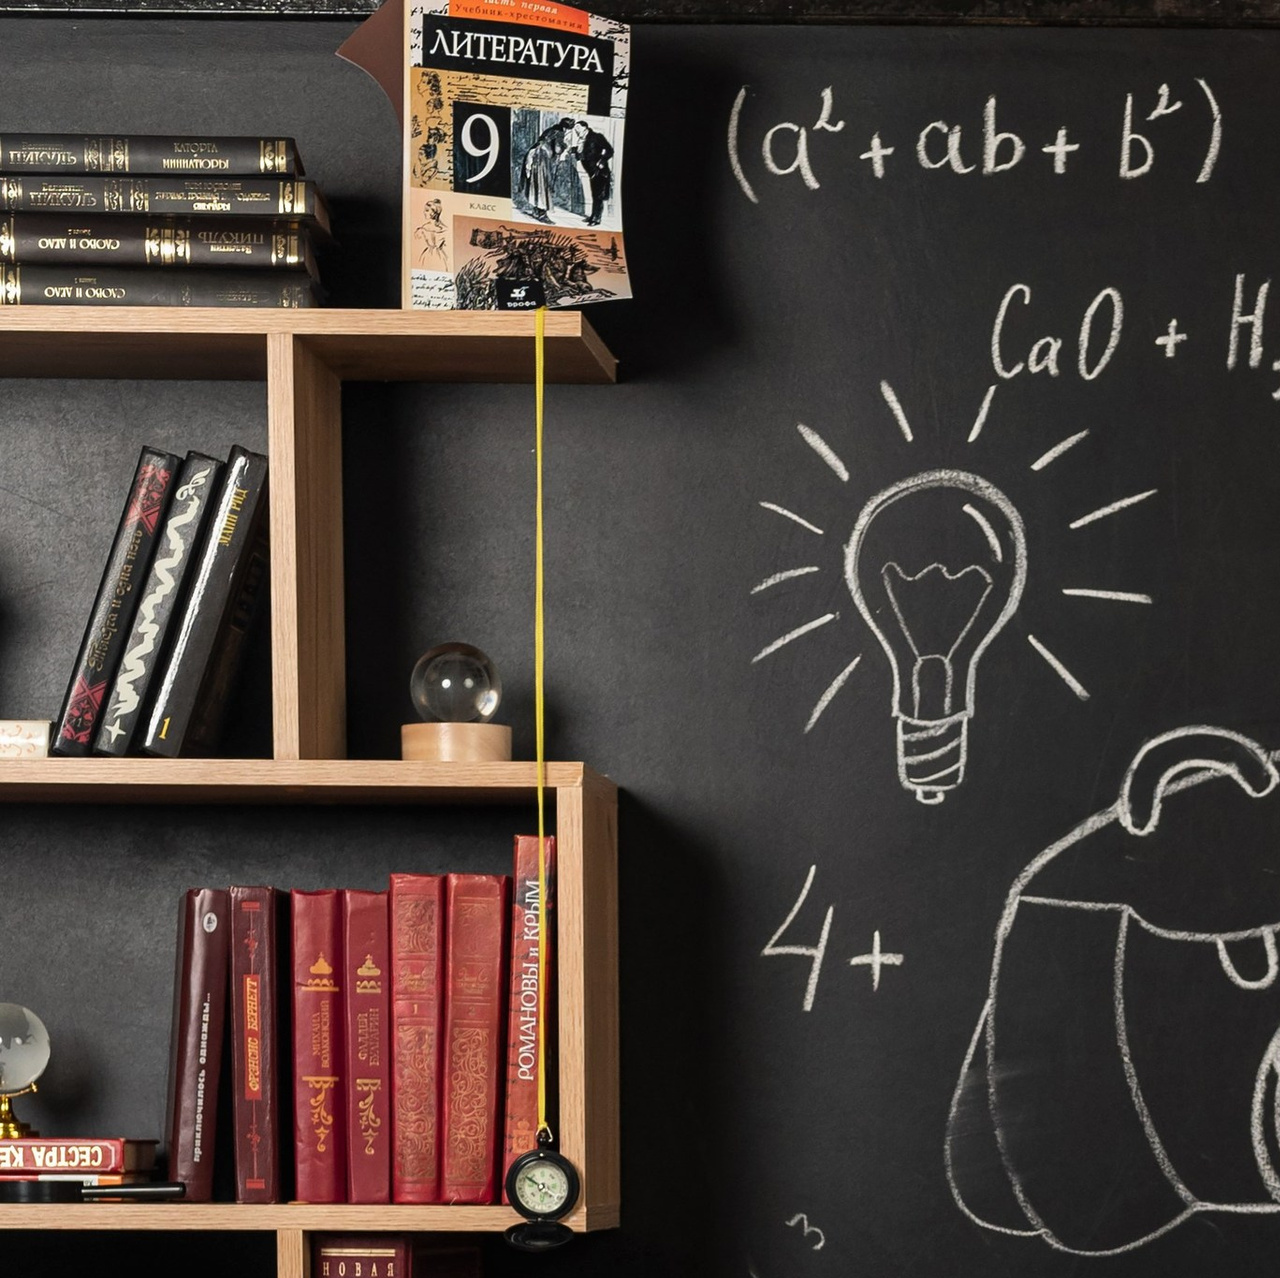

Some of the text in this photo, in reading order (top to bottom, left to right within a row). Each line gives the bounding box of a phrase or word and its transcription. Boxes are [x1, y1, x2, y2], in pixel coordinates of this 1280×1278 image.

[455, 4, 583, 30] Учебник-хрестоматия
[520, 0, 558, 15] первая
[430, 29, 604, 73] ЛИТЕРАТУРА
[9, 151, 77, 165] ПИКУЛЬ
[173, 142, 218, 153] КАТОРГА
[460, 113, 500, 183] 9
[162, 158, 229, 170] МИНИАТЮРЫ
[29, 193, 97, 206] ПИКУЛЬ
[469, 202, 497, 213] класс
[38, 238, 120, 250] СЛОВО И ДЕЛО
[198, 232, 264, 245] ПИКУЛЬ
[44, 287, 126, 299] СЛОВО И ДЕЛО
[992, 283, 1124, 380] CaO
[116, 562, 134, 596] одна
[158, 717, 172, 740] 1
[517, 880, 541, 1081] РОМАНОВЫ и КРЫМ
[412, 1003, 419, 1015] 1
[246, 977, 260, 1092] ФРЭНСИС БЕРНЕТТ
[311, 1012, 321, 1056] МИХАИЛ
[320, 999, 330, 1068] ВОЛКОНСКИЙ
[357, 1012, 370, 1060] ФАДДЕЙ
[368, 1008, 380, 1067] БУЛГАРИН
[192, 992, 210, 1163] приключилось однажды...
[32, 1145, 103, 1168] СЕСТРА
[322, 1261, 395, 1278] НОВАЯ
